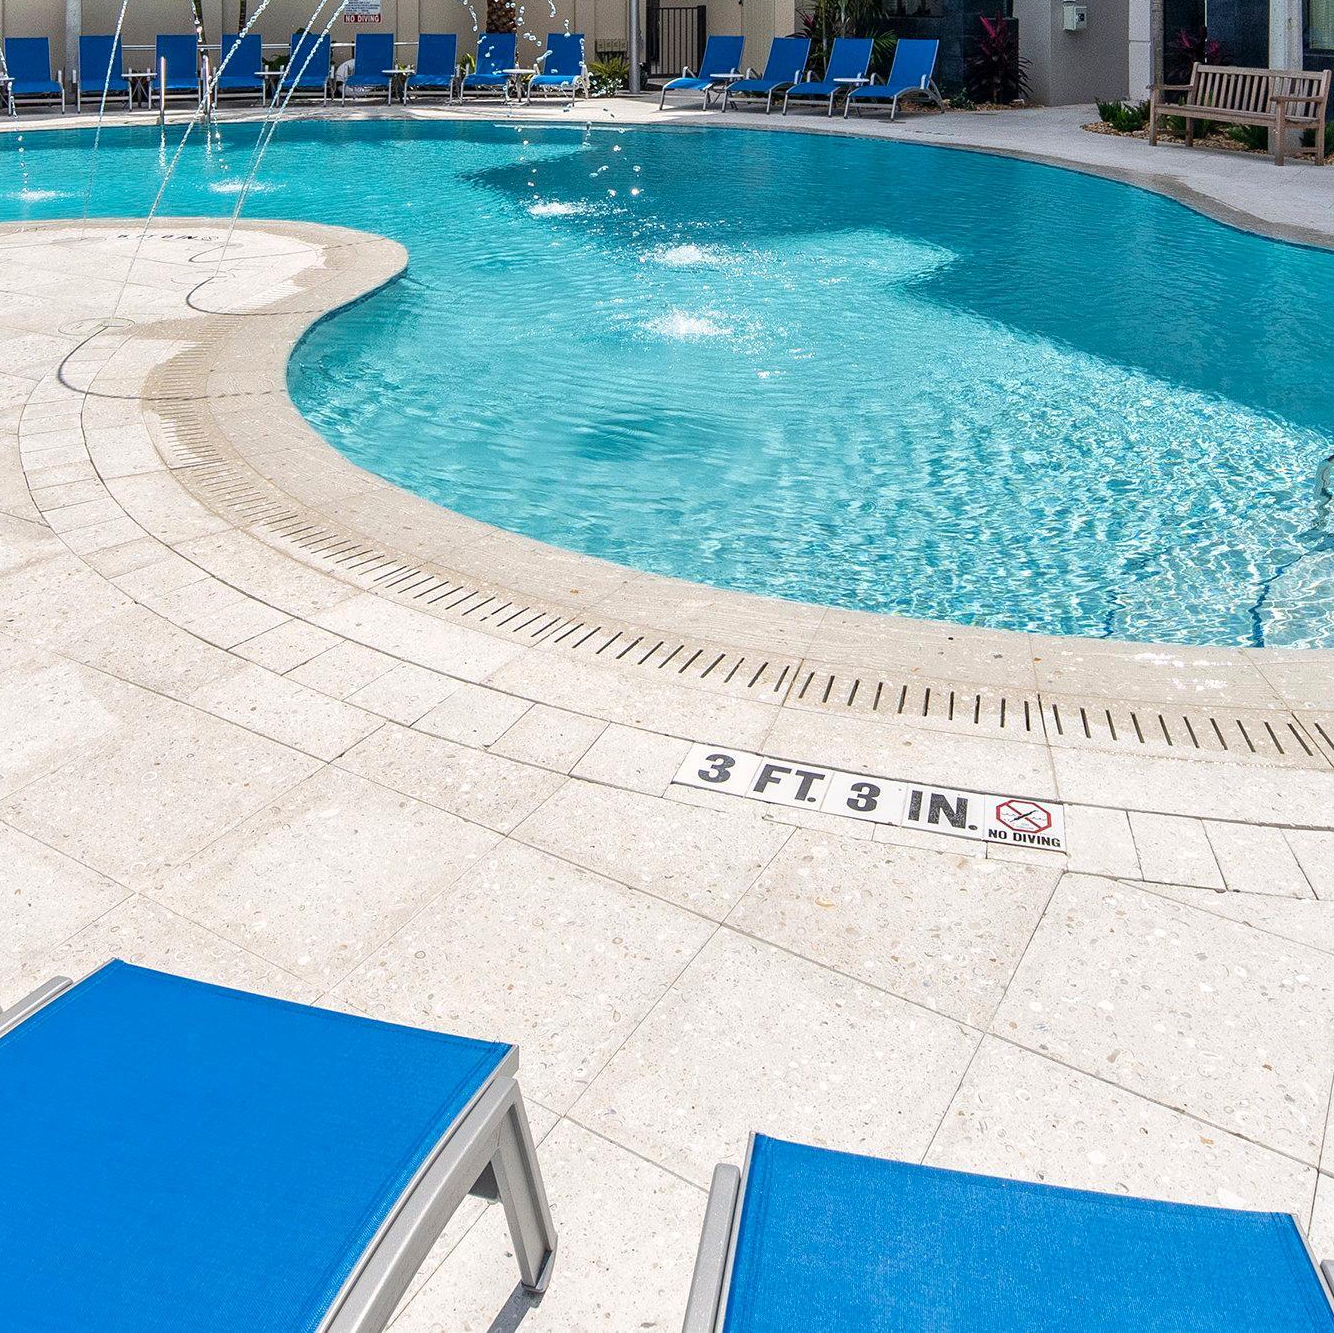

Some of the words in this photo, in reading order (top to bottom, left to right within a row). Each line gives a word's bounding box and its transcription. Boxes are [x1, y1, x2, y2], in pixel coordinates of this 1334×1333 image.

[697, 753, 736, 783] 3
[752, 763, 826, 804] FT.
[846, 782, 882, 813] 3
[908, 789, 979, 832] IN.
[988, 829, 1008, 840] NO
[1012, 832, 1061, 848] DIVING
